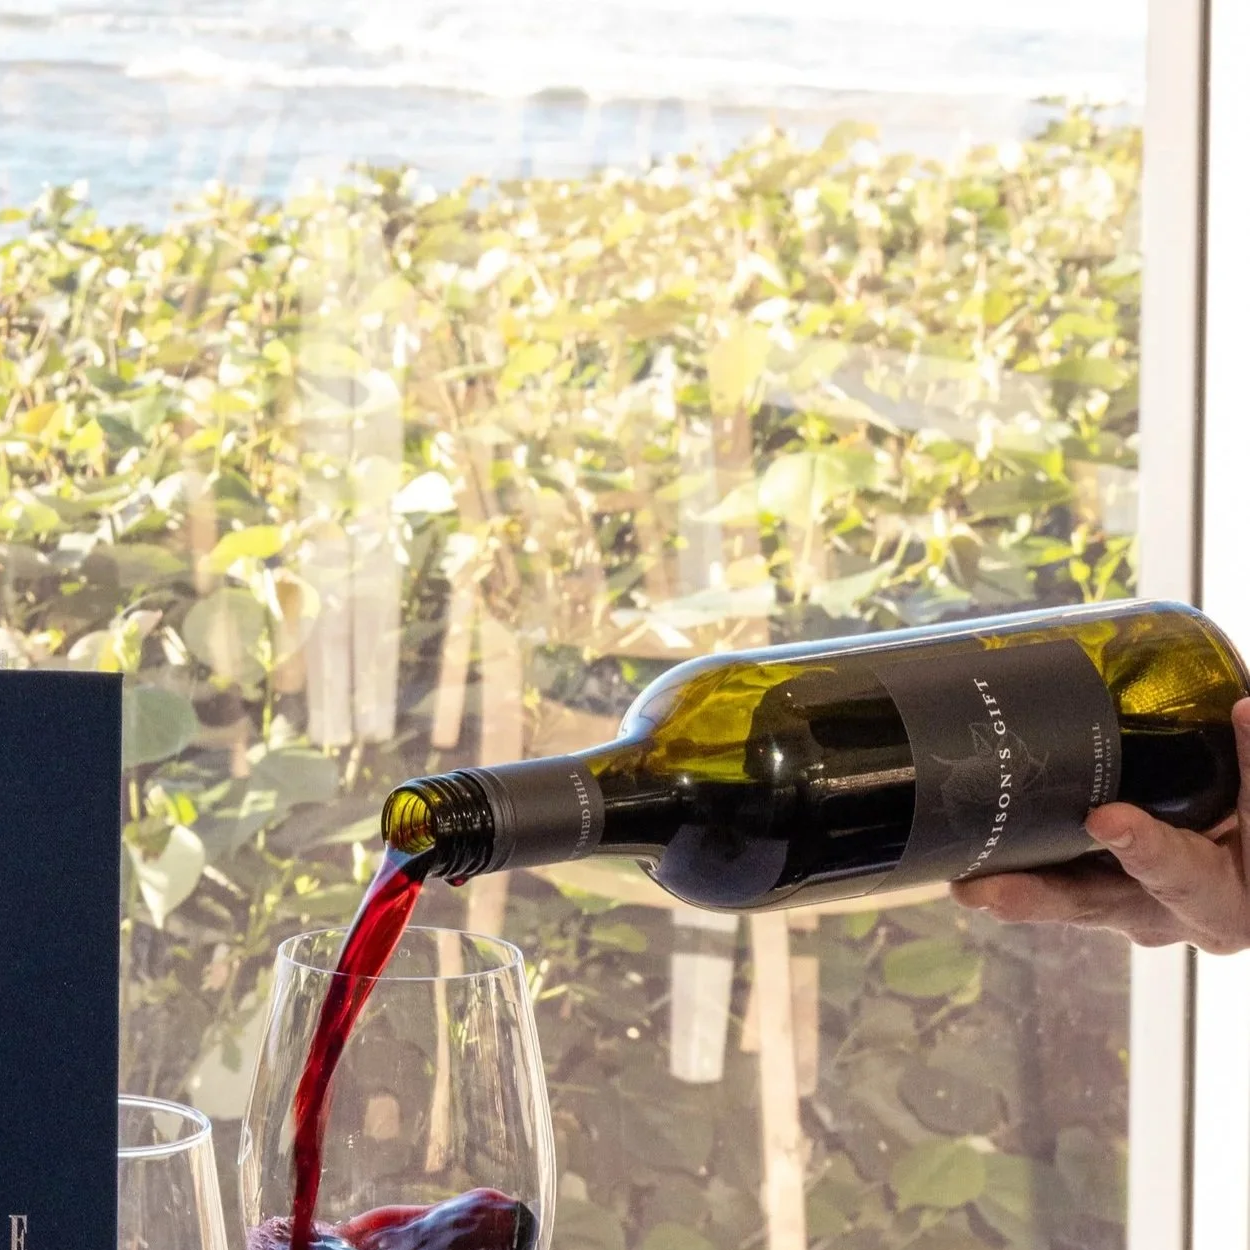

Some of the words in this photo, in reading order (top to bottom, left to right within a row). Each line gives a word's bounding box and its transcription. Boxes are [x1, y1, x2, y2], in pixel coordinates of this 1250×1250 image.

[973, 678, 1007, 735] GIFT
[1091, 722, 1103, 759] HILL
[569, 770, 590, 806] HILL
[1090, 763, 1103, 802] SHED
[575, 808, 591, 848] SHED
